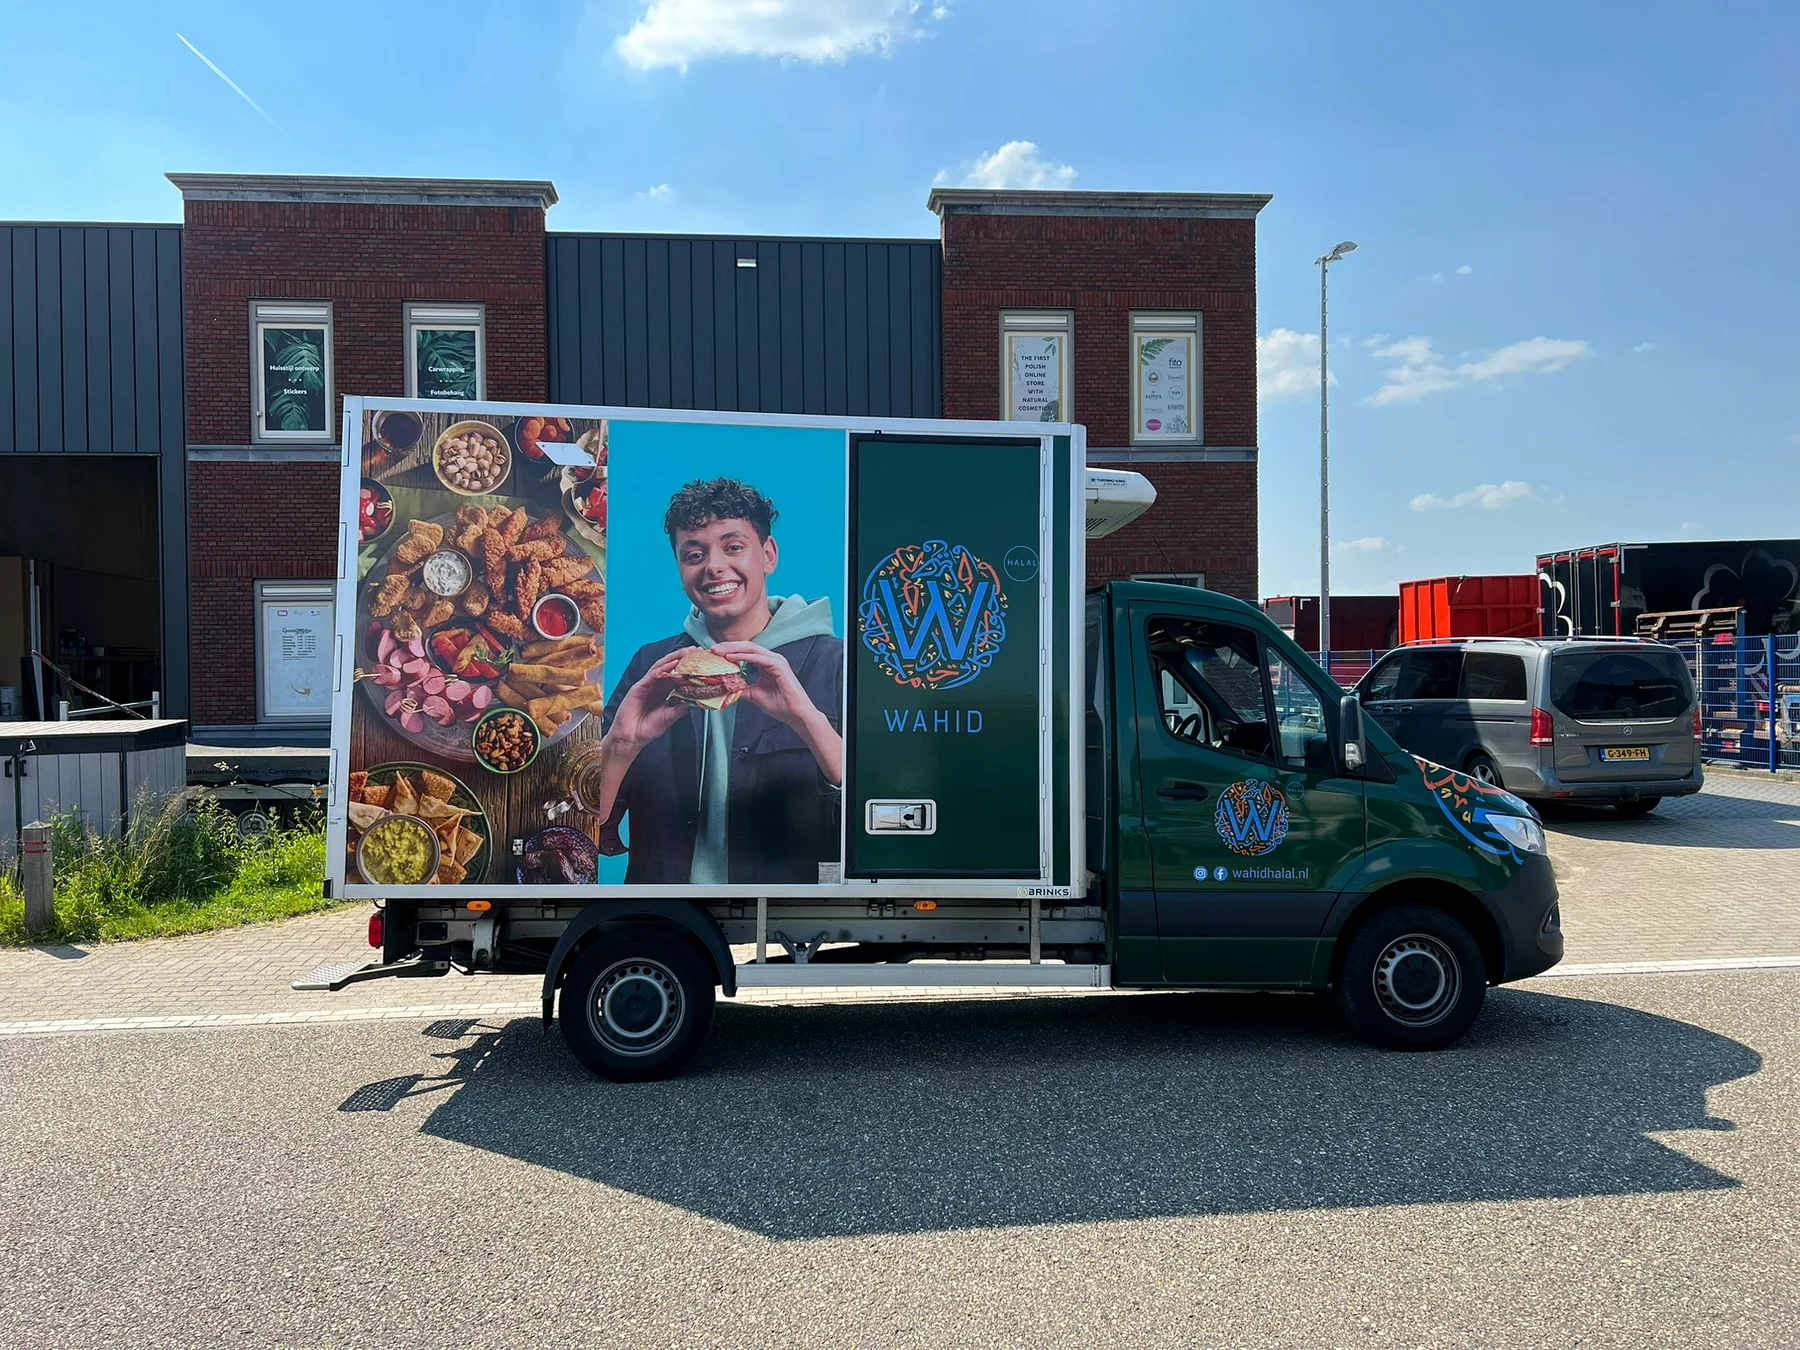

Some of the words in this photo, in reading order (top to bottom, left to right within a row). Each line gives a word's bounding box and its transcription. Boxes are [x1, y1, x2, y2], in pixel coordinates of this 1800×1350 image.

[269, 364, 294, 372] Huisstijl
[428, 366, 465, 374] Carwrapping
[430, 389, 465, 397] Fotobehang
[1007, 559, 1037, 567] HALAL
[883, 709, 984, 733] WAHID
[1607, 749, 1647, 758] G-349-FH
[1232, 867, 1309, 879] wahidhalal.nl
[1028, 888, 1069, 896] BRINKS
